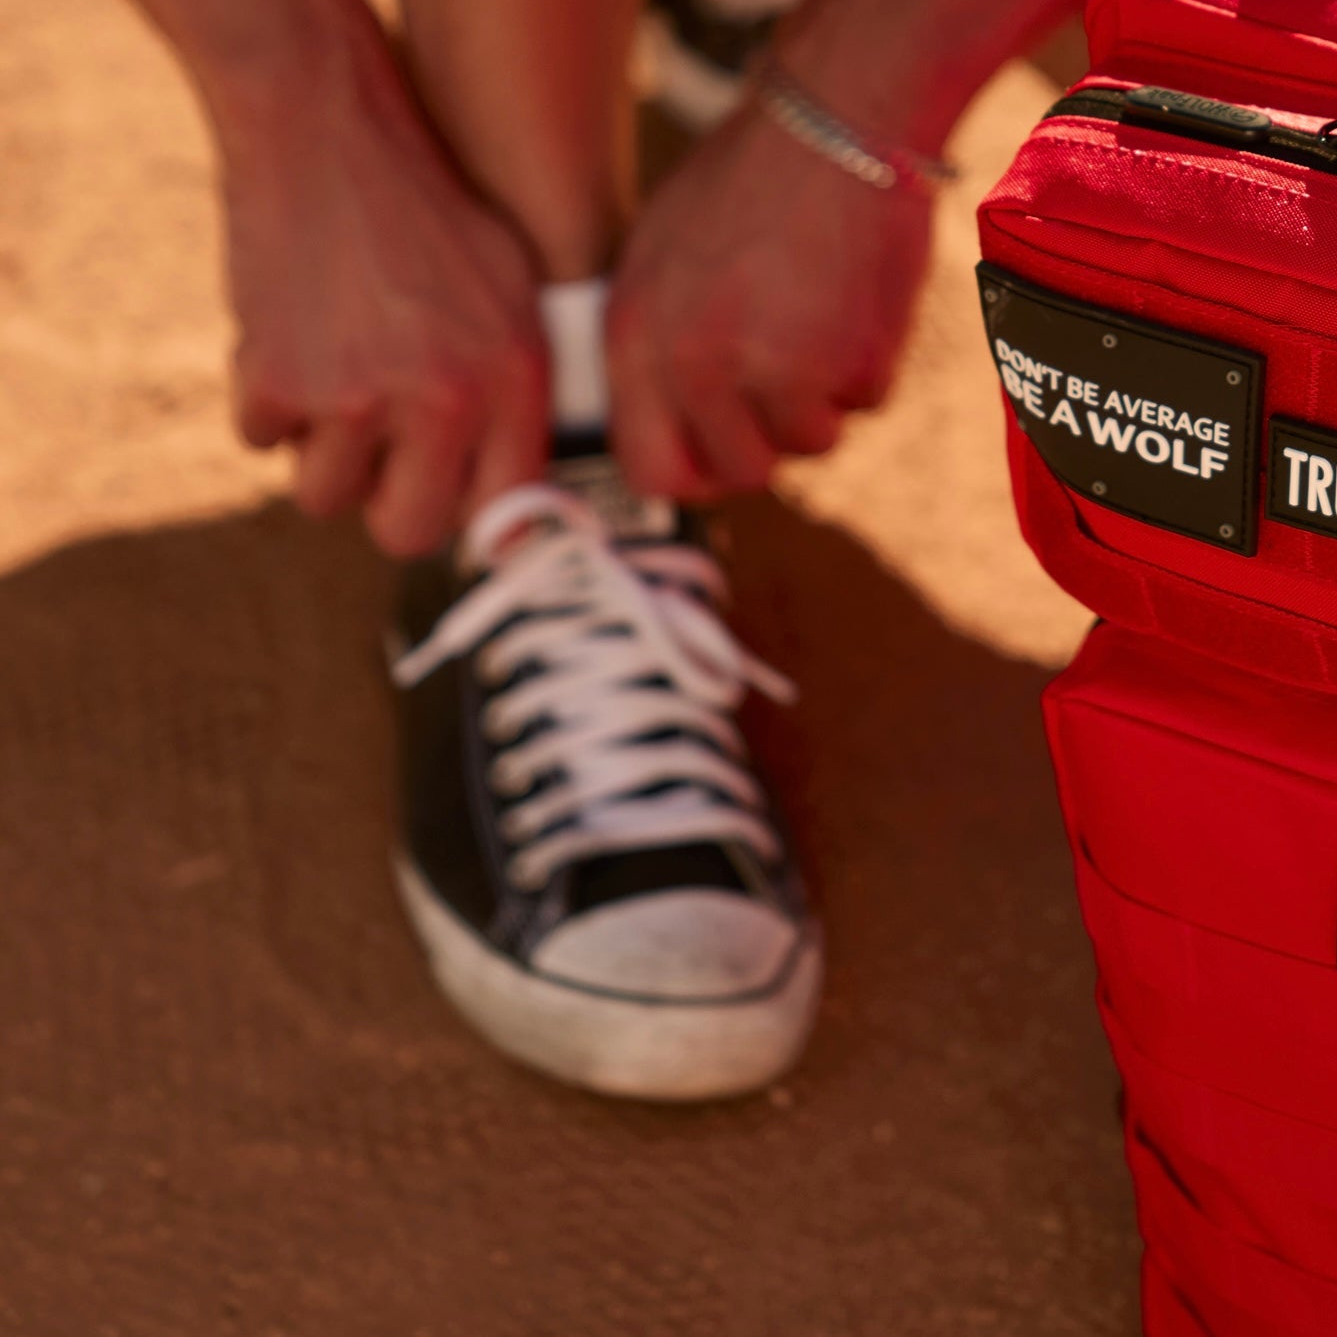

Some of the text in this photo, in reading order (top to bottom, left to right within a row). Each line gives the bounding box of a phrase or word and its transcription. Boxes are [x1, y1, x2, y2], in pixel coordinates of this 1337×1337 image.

[996, 338, 1231, 447] DON'T BE AVERAGE
[1001, 363, 1229, 479] BE A WOLF
